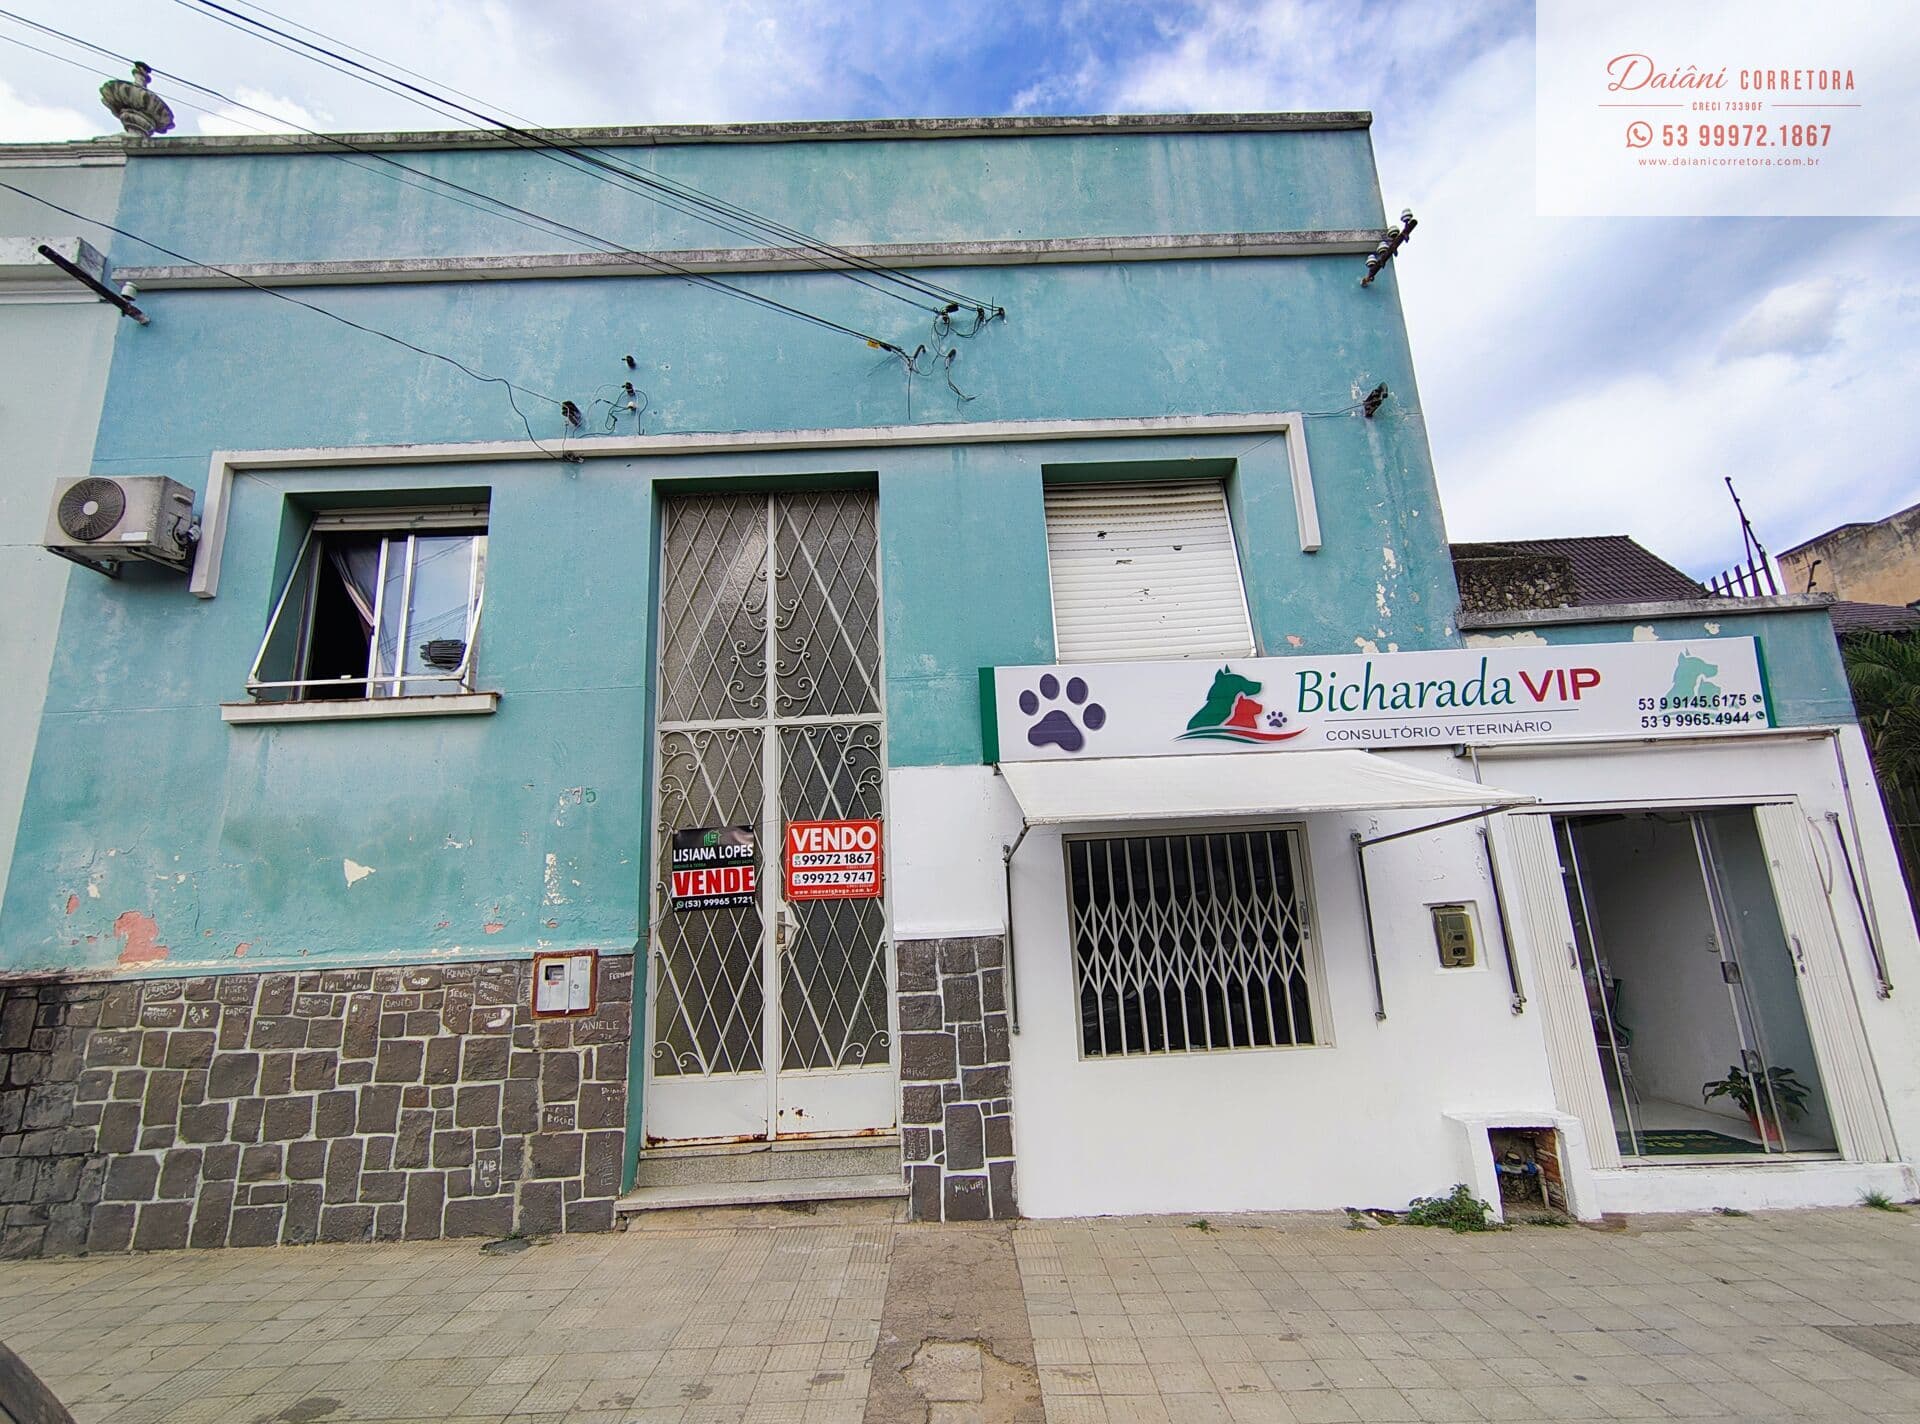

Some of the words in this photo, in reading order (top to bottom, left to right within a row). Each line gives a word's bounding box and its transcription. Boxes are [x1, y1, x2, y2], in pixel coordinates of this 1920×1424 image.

[1295, 656, 1516, 713] Bicharada
[1518, 667, 1601, 702] VIP
[1638, 697, 1655, 711] 53
[1660, 696, 1668, 710] 9
[1672, 693, 1748, 709] 9145.6175
[1641, 715, 1658, 729] 53
[1662, 714, 1671, 728] 9
[1675, 711, 1750, 727] 9965.4944
[1325, 725, 1441, 742] CONSULTÓRIO
[1445, 719, 1552, 737] VETERINÁRIO
[791, 825, 877, 852] VENDO
[673, 847, 717, 863] LISIANA
[718, 843, 754, 859] LOPES
[801, 854, 841, 866] 99972
[844, 852, 873, 864] 1867
[673, 866, 755, 897] VENDE
[802, 873, 840, 884] 99922
[843, 871, 873, 883] 9747
[684, 900, 702, 909] (53)
[703, 897, 730, 907] 99965
[732, 895, 753, 905] 1721
